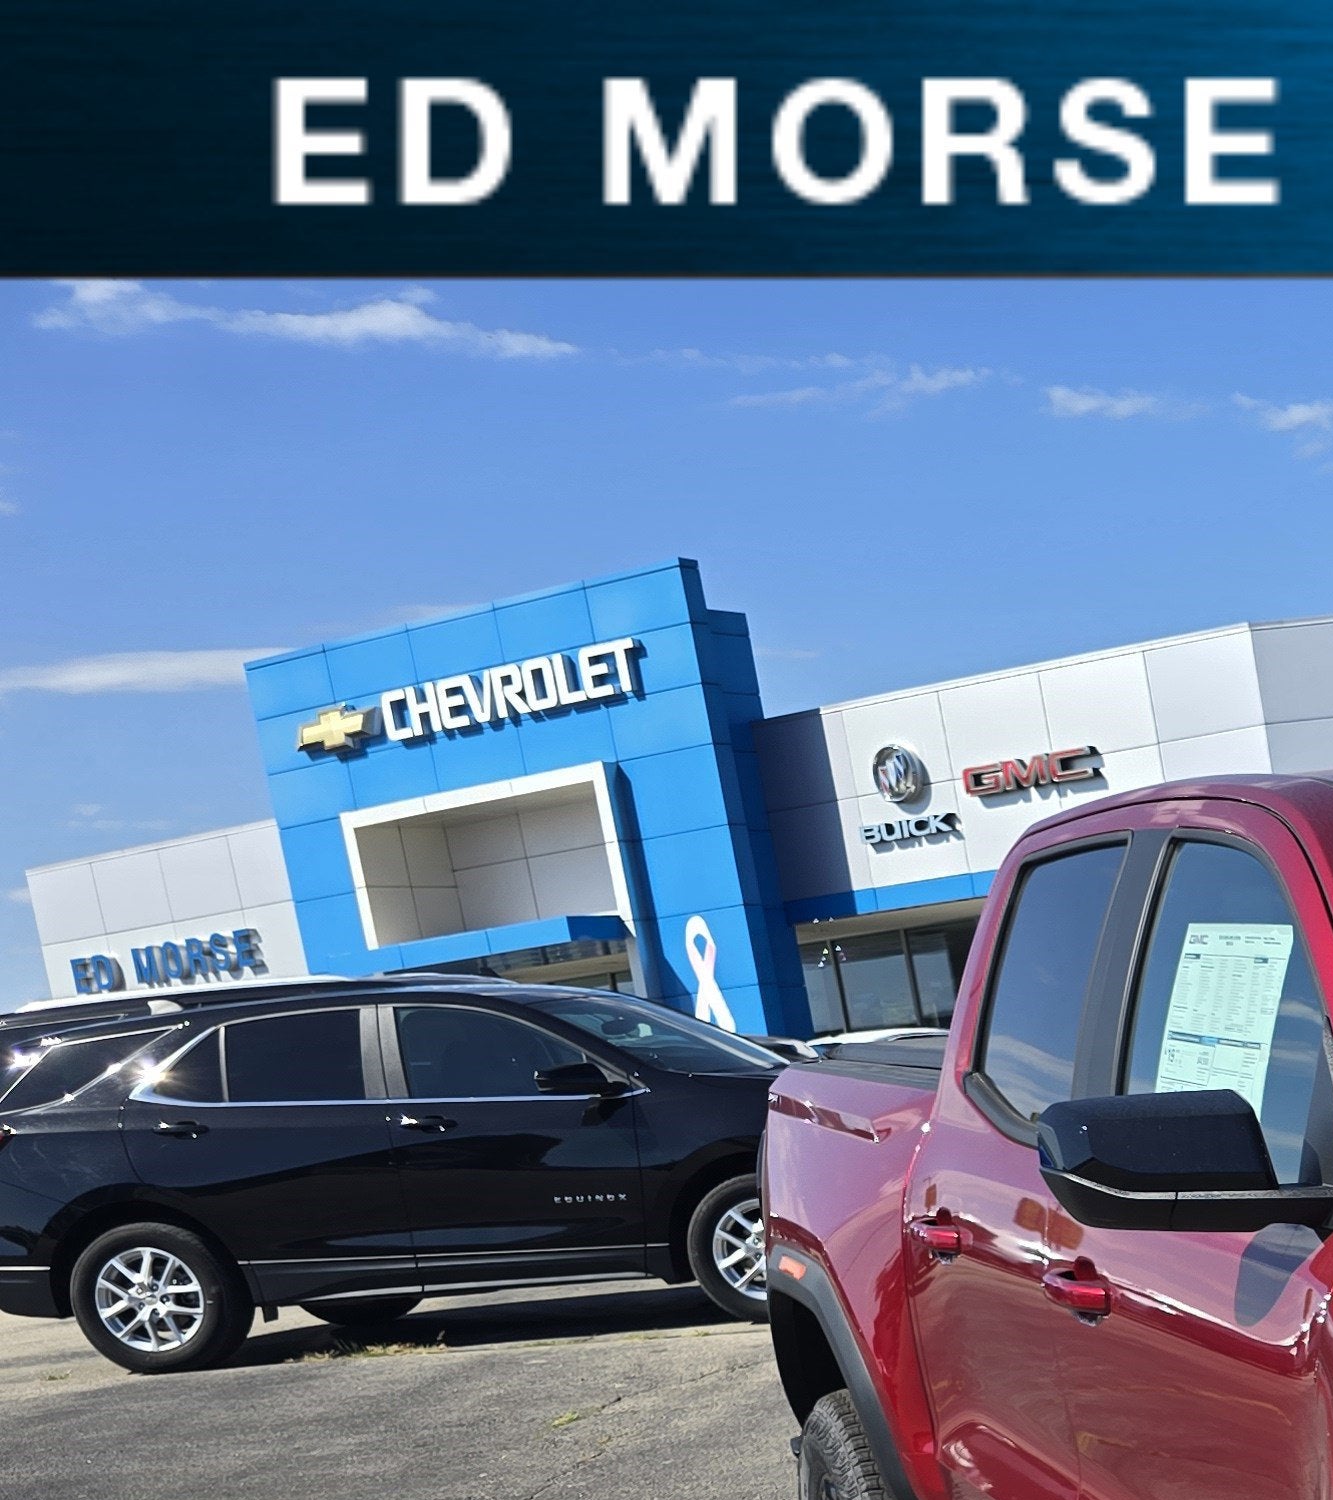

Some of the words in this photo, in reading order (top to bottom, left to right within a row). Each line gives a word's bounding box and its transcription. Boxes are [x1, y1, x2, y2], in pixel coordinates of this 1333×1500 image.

[380, 637, 636, 742] CHEVROLET
[962, 745, 1096, 797] GMC
[860, 812, 953, 845] BUICK
[70, 954, 117, 995] ED
[130, 928, 259, 986] MORSE
[553, 1192, 628, 1205] EQUINOX
